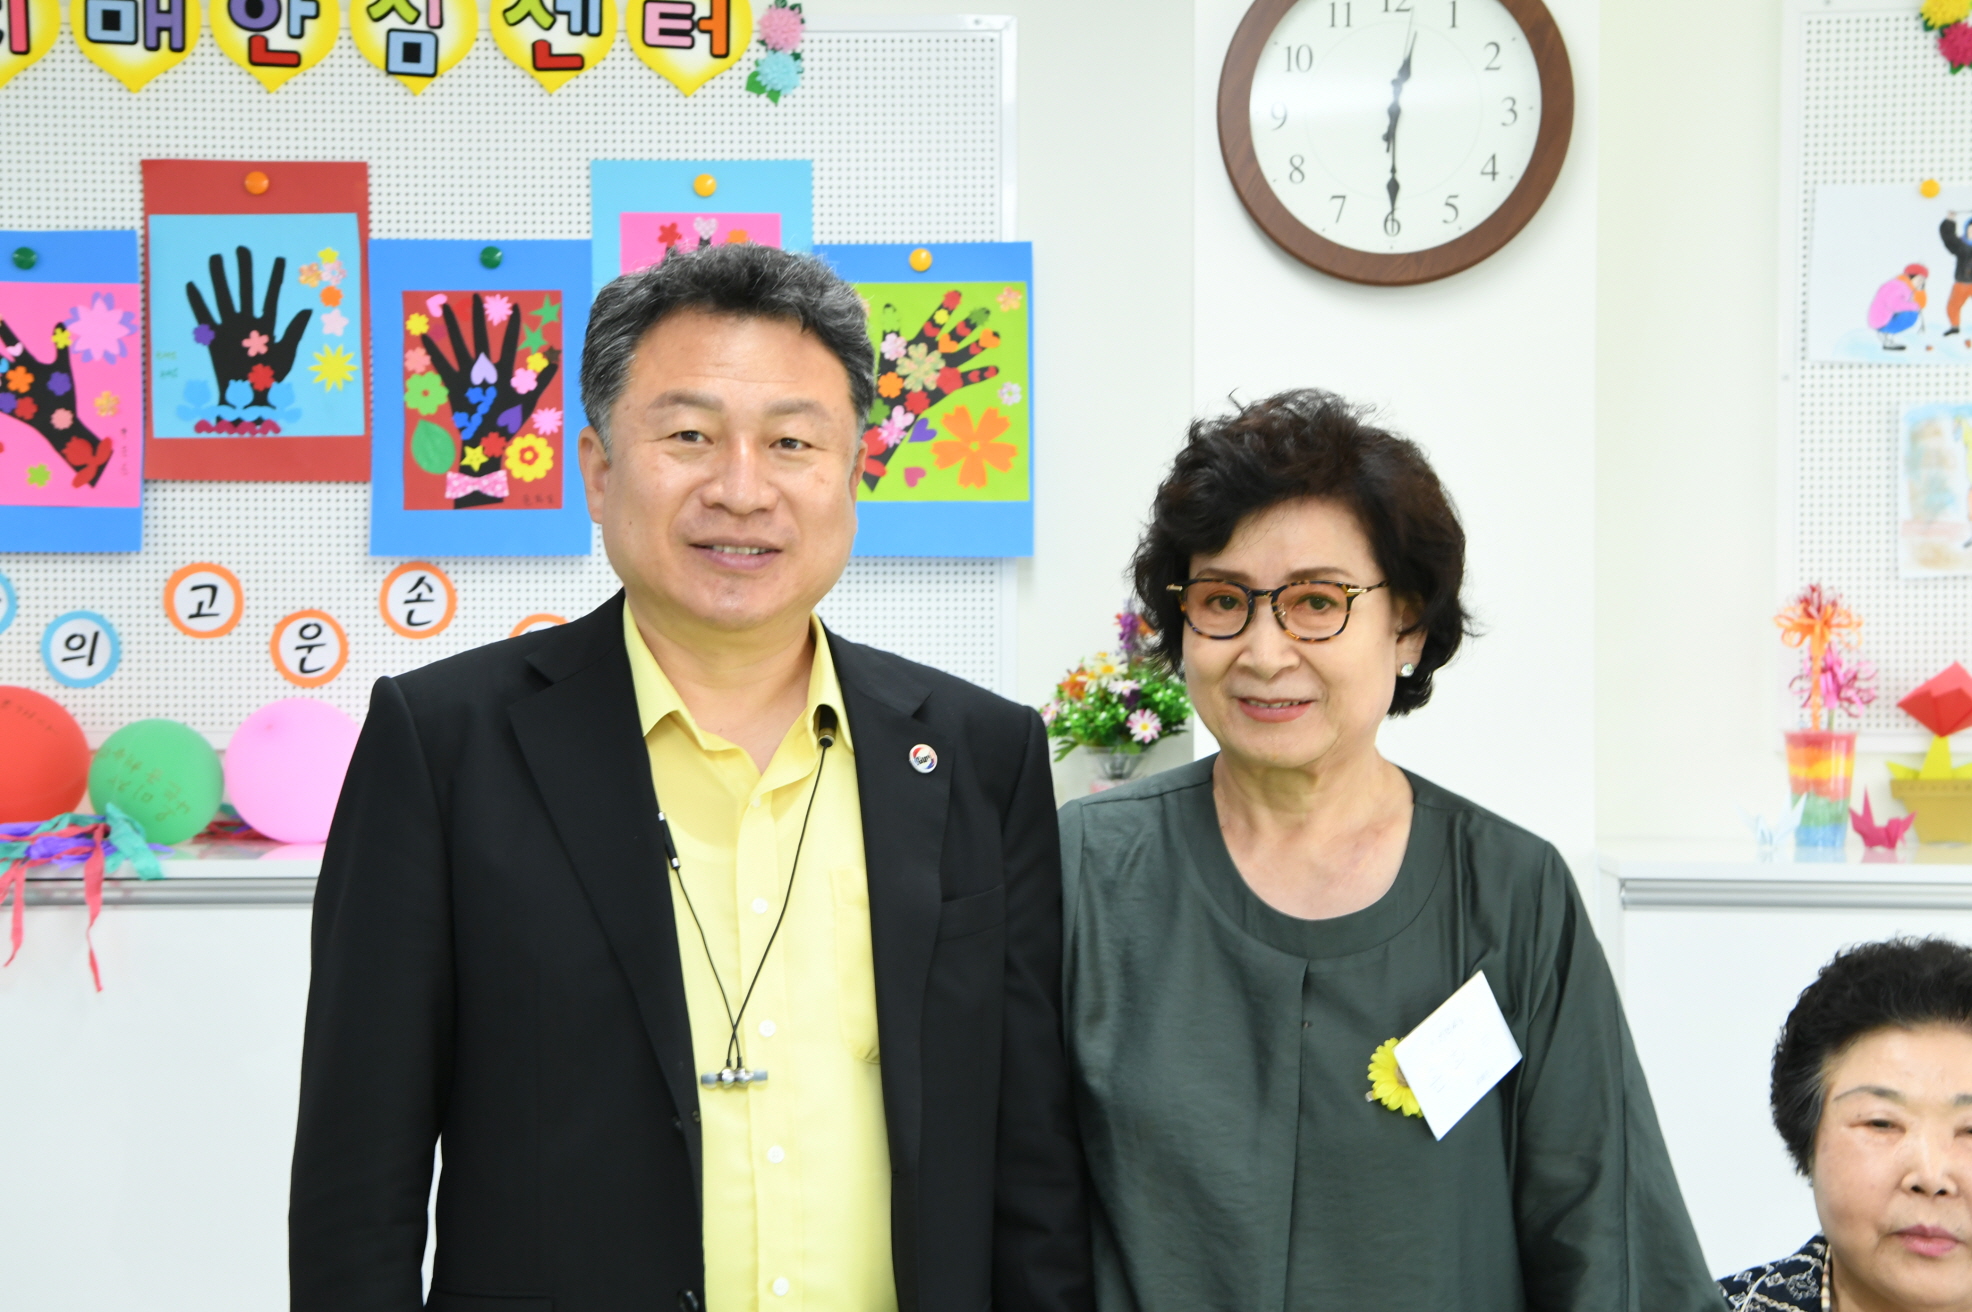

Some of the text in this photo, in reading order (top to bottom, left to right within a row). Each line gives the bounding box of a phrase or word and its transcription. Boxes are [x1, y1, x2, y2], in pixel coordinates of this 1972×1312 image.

[1328, 1, 1352, 28] 11
[1448, 0, 1459, 29] 1
[1284, 44, 1313, 72] 10
[1484, 41, 1501, 71] 2
[1271, 102, 1288, 131] 9
[1501, 97, 1518, 127] 3
[1289, 154, 1306, 184] 8
[1480, 153, 1500, 182] 4
[1329, 195, 1347, 223] 7
[1383, 207, 1402, 236] 6
[1442, 195, 1460, 224] 5
[61, 630, 100, 667] 의
